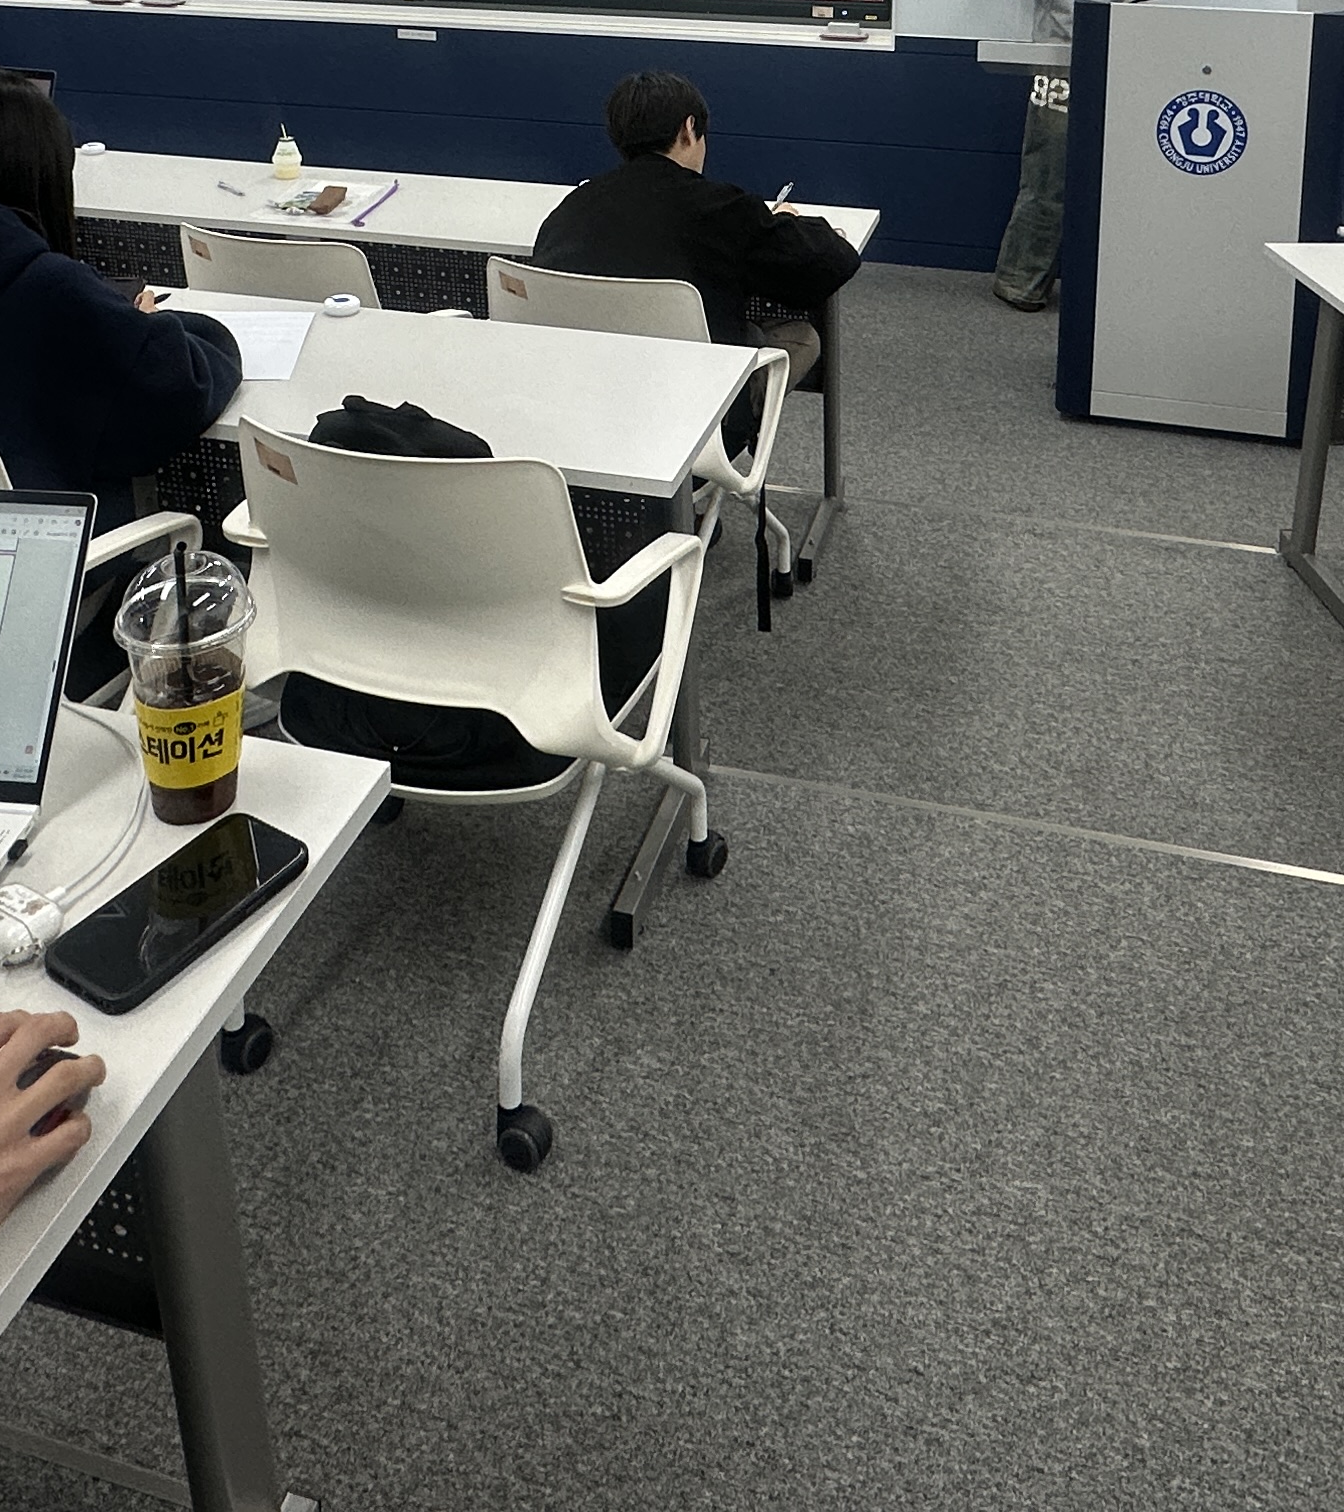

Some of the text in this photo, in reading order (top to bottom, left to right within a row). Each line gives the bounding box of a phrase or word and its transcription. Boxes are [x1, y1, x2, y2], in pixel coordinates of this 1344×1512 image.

[1160, 109, 1174, 130] 1924
[1233, 116, 1245, 138] 1947
[1159, 134, 1244, 173] CHEONGJU UNIVERSITY
